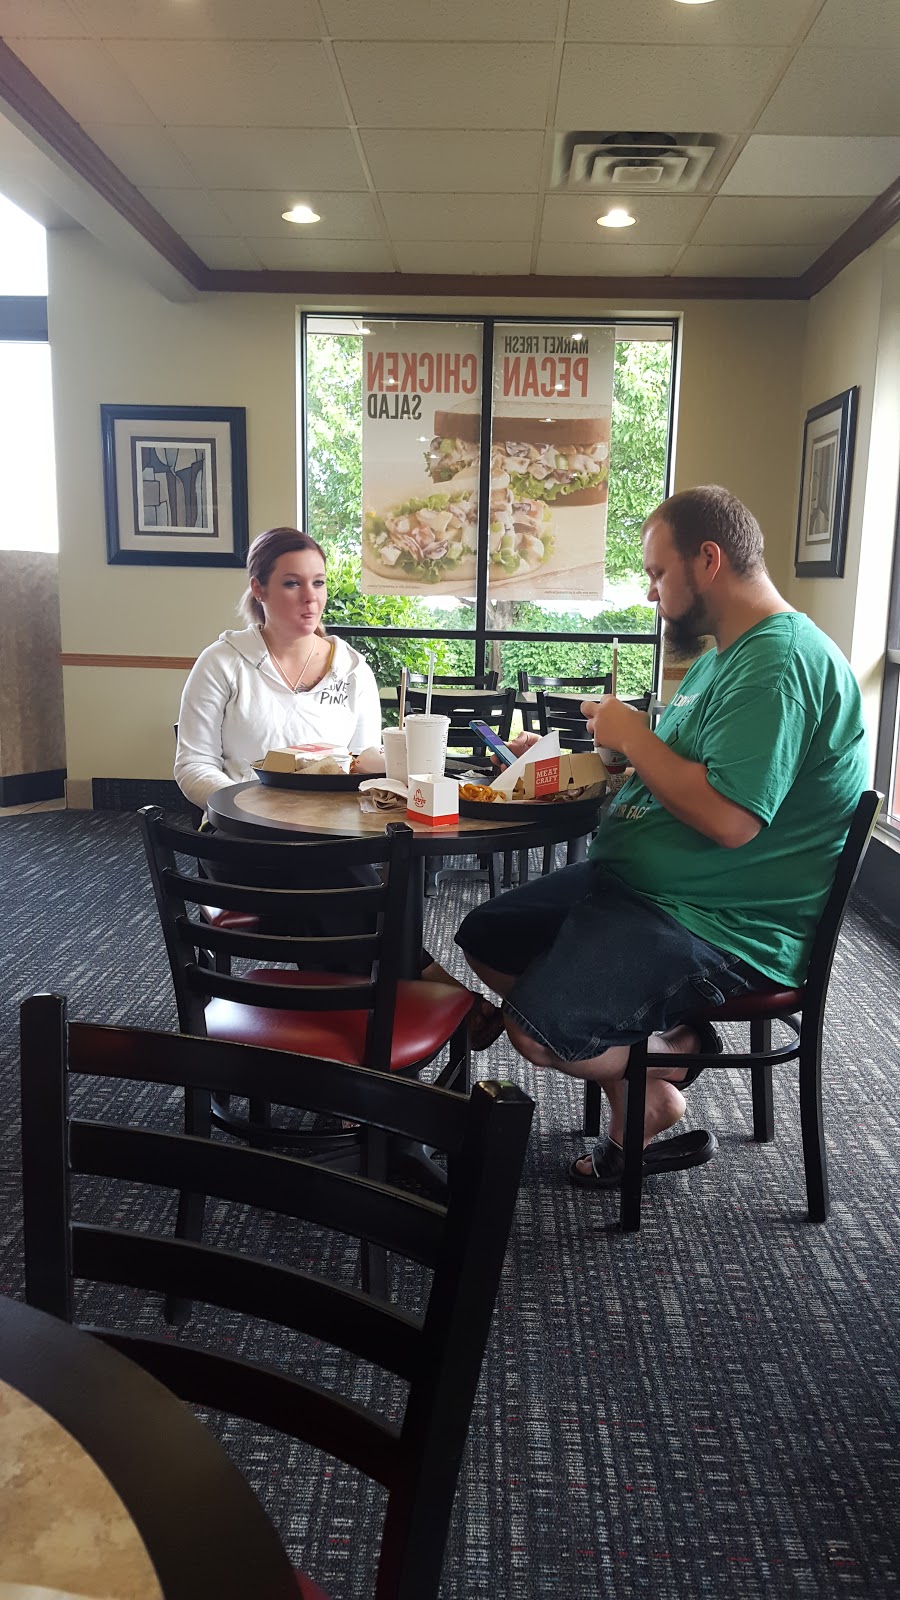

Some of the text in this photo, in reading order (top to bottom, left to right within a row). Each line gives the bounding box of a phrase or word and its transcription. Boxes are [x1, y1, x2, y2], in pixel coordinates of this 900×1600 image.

[319, 691, 348, 707] PINK
[536, 767, 558, 779] MEAT
[535, 774, 558, 785] CRAFT
